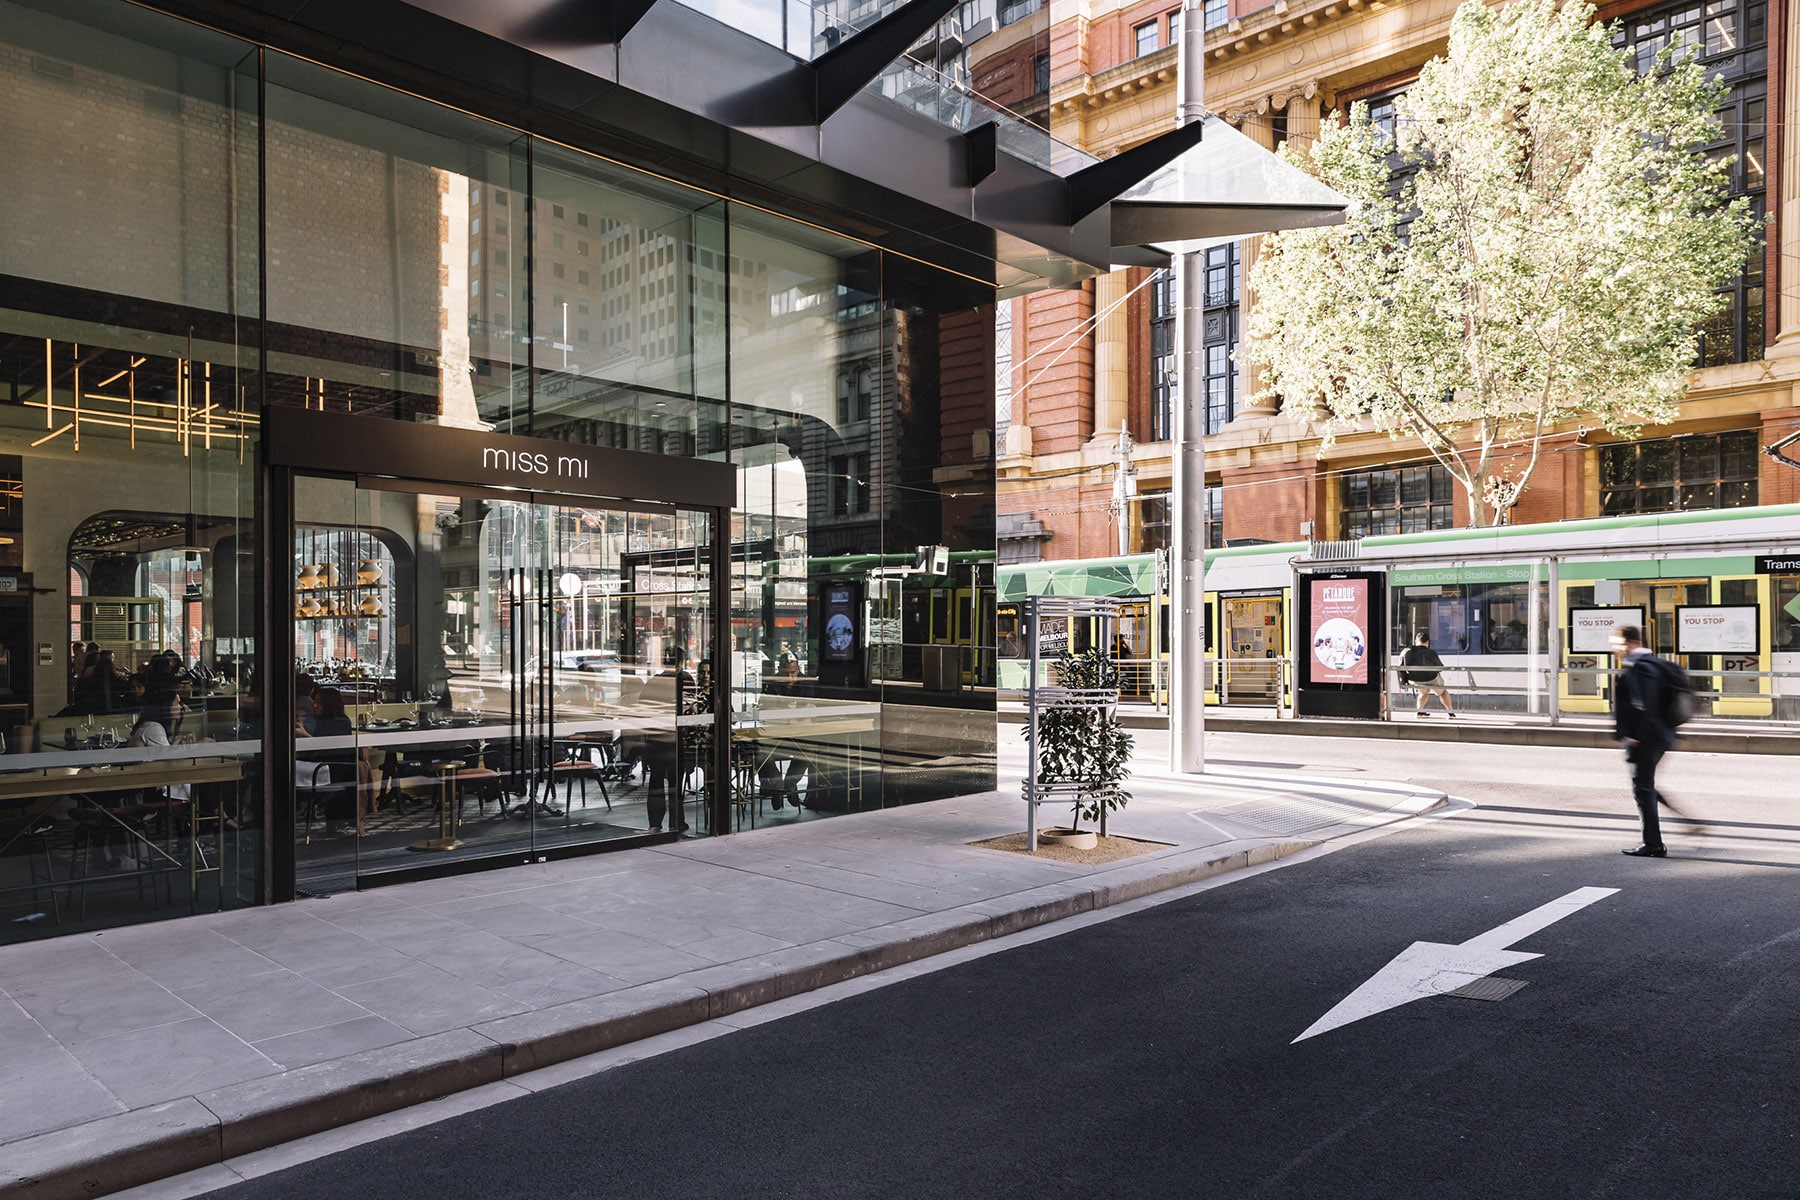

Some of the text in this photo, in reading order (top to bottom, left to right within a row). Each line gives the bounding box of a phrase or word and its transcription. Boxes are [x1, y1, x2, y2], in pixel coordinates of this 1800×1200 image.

[483, 447, 588, 479] miss mi
[1764, 559, 1800, 569] Trams
[1394, 572, 1434, 582] Southern
[1436, 571, 1462, 581] Cross
[1464, 570, 1497, 580] Station
[1506, 569, 1529, 579] Stop
[1703, 617, 1725, 625] STOP
